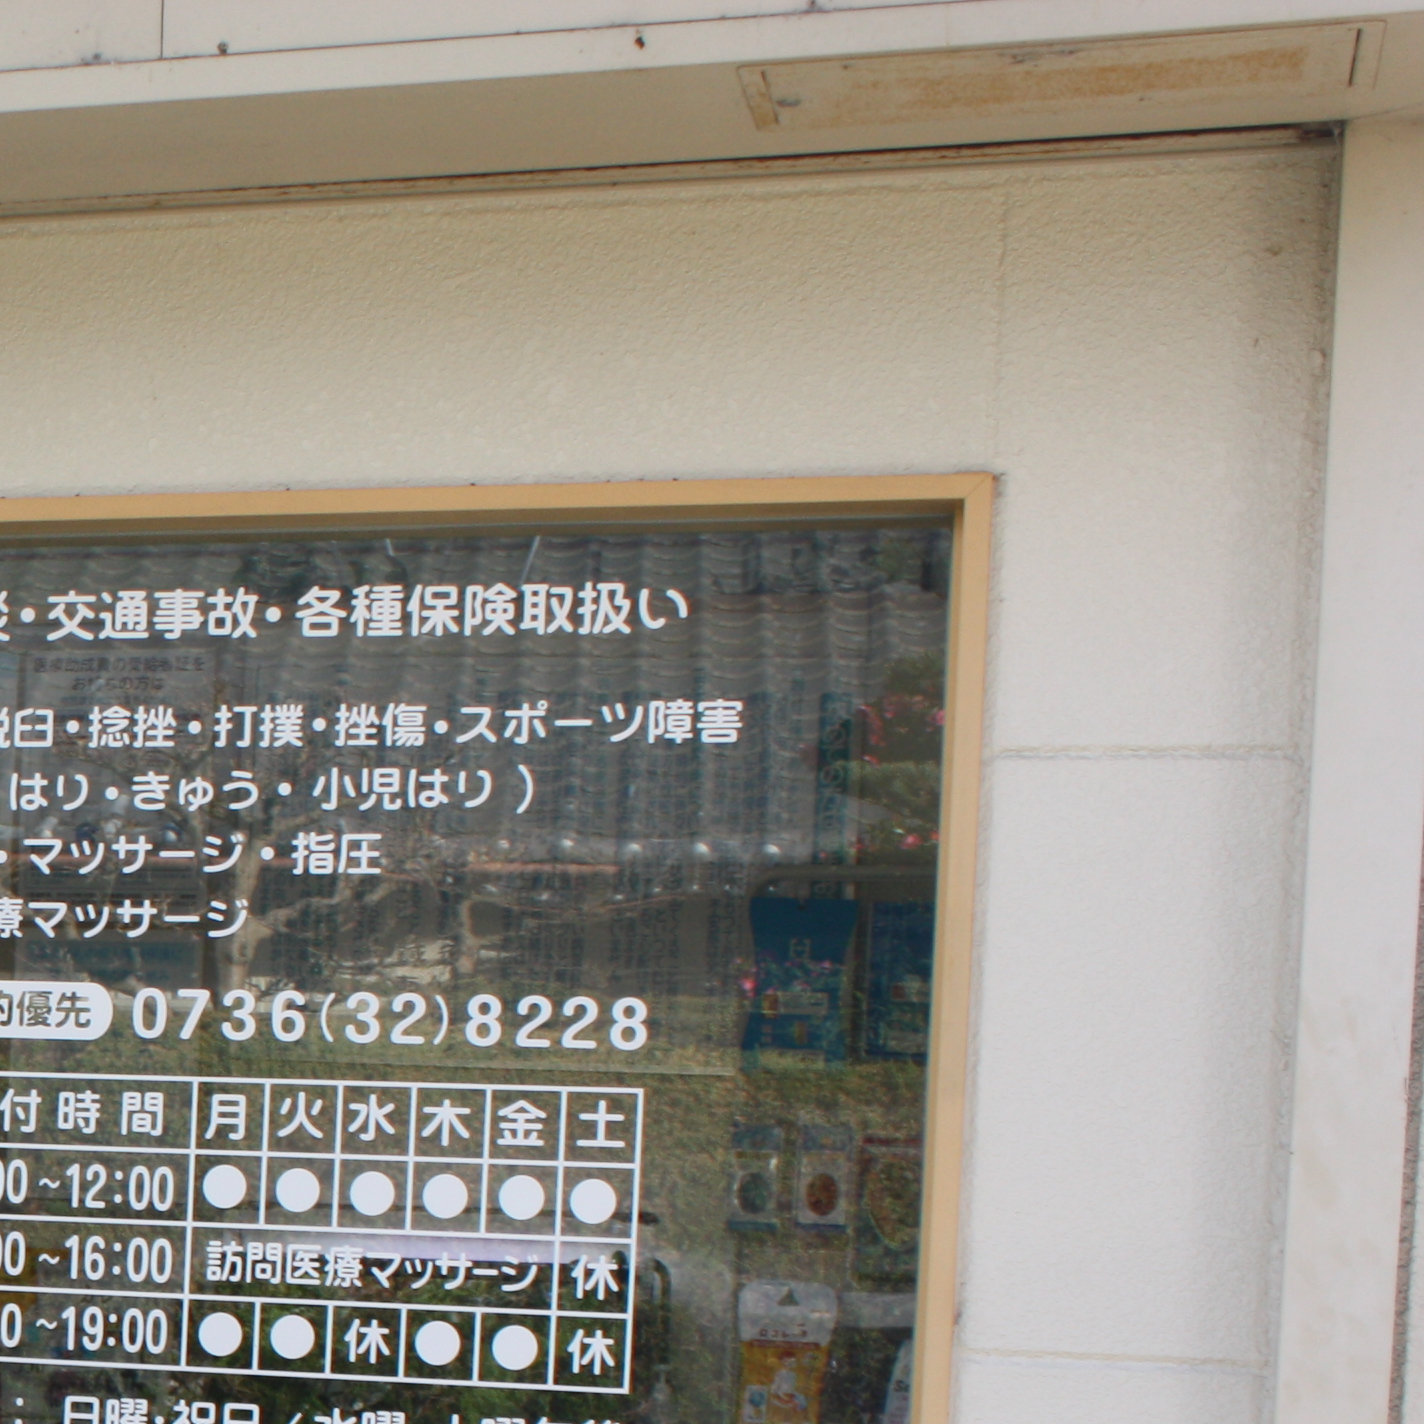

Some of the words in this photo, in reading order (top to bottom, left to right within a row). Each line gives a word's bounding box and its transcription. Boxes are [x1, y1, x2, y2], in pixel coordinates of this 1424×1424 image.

[132, 987, 647, 1051] 0736(32)8228
[205, 1093, 247, 1141] 月
[277, 1092, 323, 1139] 火
[348, 1093, 396, 1141] 水
[421, 1099, 471, 1147] 木
[496, 1099, 547, 1147] 金
[576, 1099, 626, 1148] 土
[206, 1240, 539, 1292] 訪問医療マッサージ
[570, 1254, 618, 1301] 休
[345, 1318, 390, 1364] 休
[568, 1329, 615, 1375] 休
